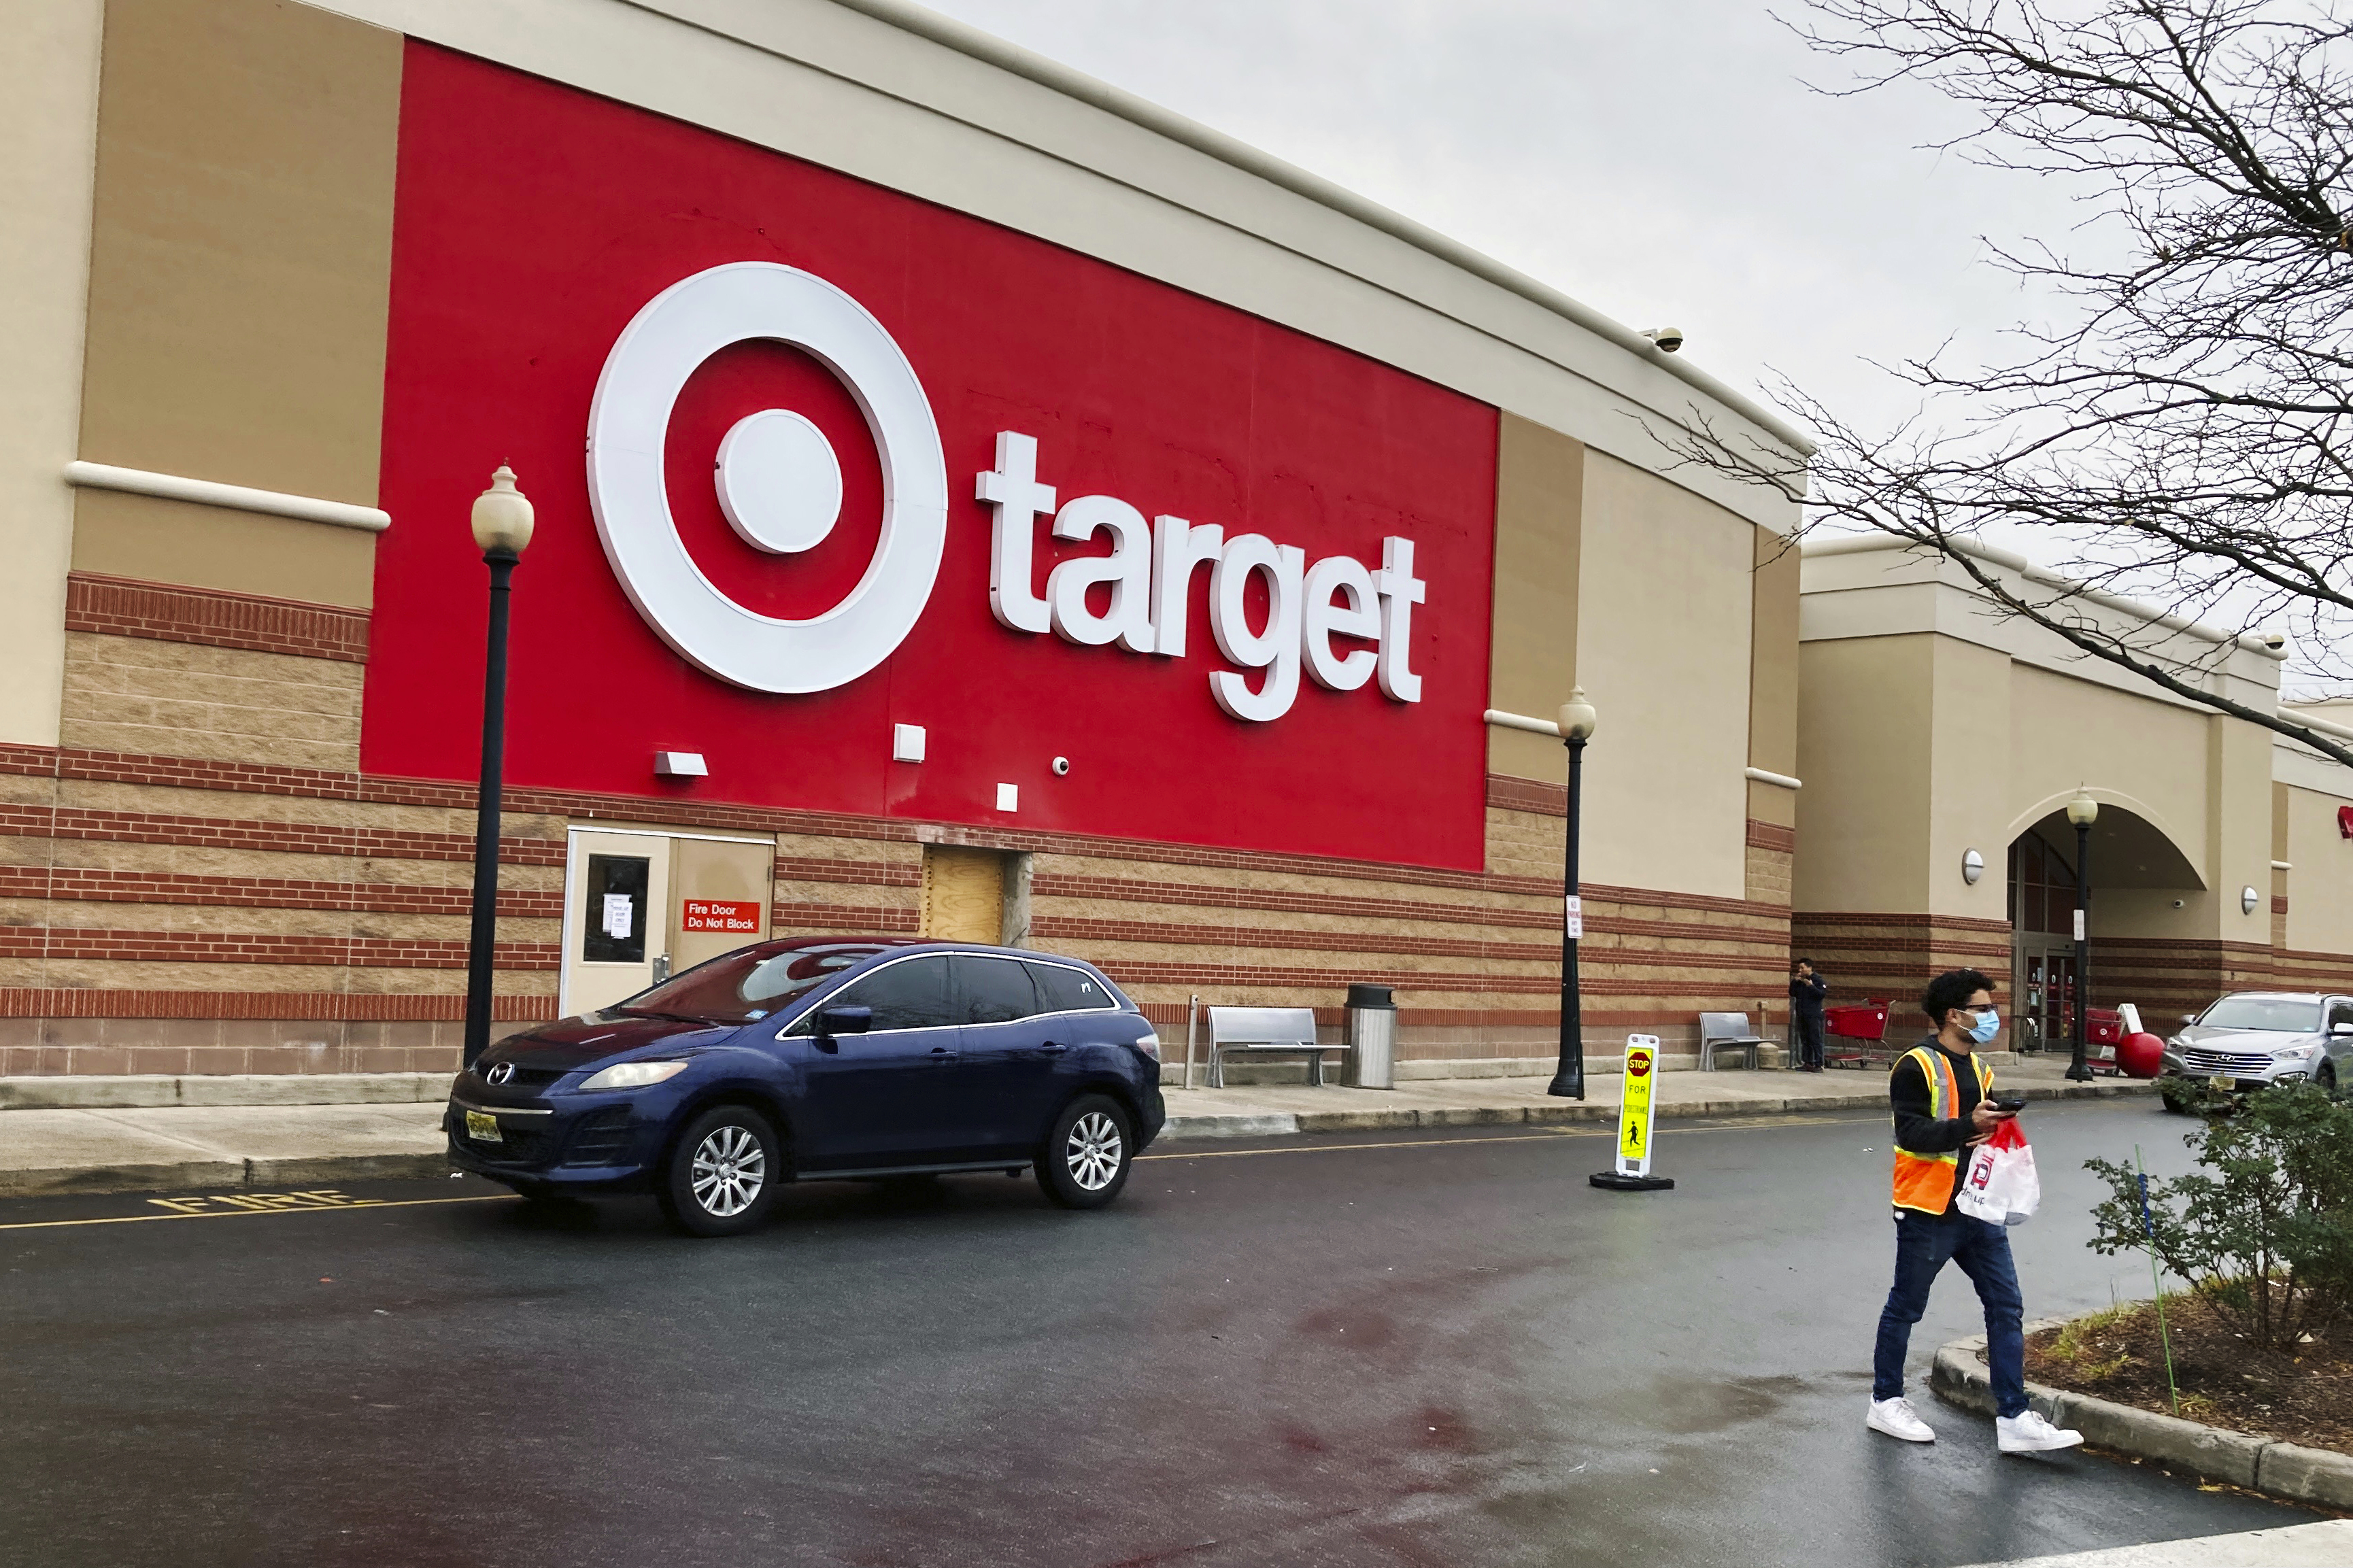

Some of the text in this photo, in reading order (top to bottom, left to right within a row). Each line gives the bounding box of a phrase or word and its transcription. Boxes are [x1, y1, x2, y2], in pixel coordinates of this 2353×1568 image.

[975, 430, 1425, 722] target
[689, 903, 737, 915] Fire Door
[688, 917, 754, 930] Do Not Block
[1629, 1059, 1650, 1069] STOP
[1629, 1085, 1646, 1094] FOR
[146, 1189, 392, 1213] FIRE
